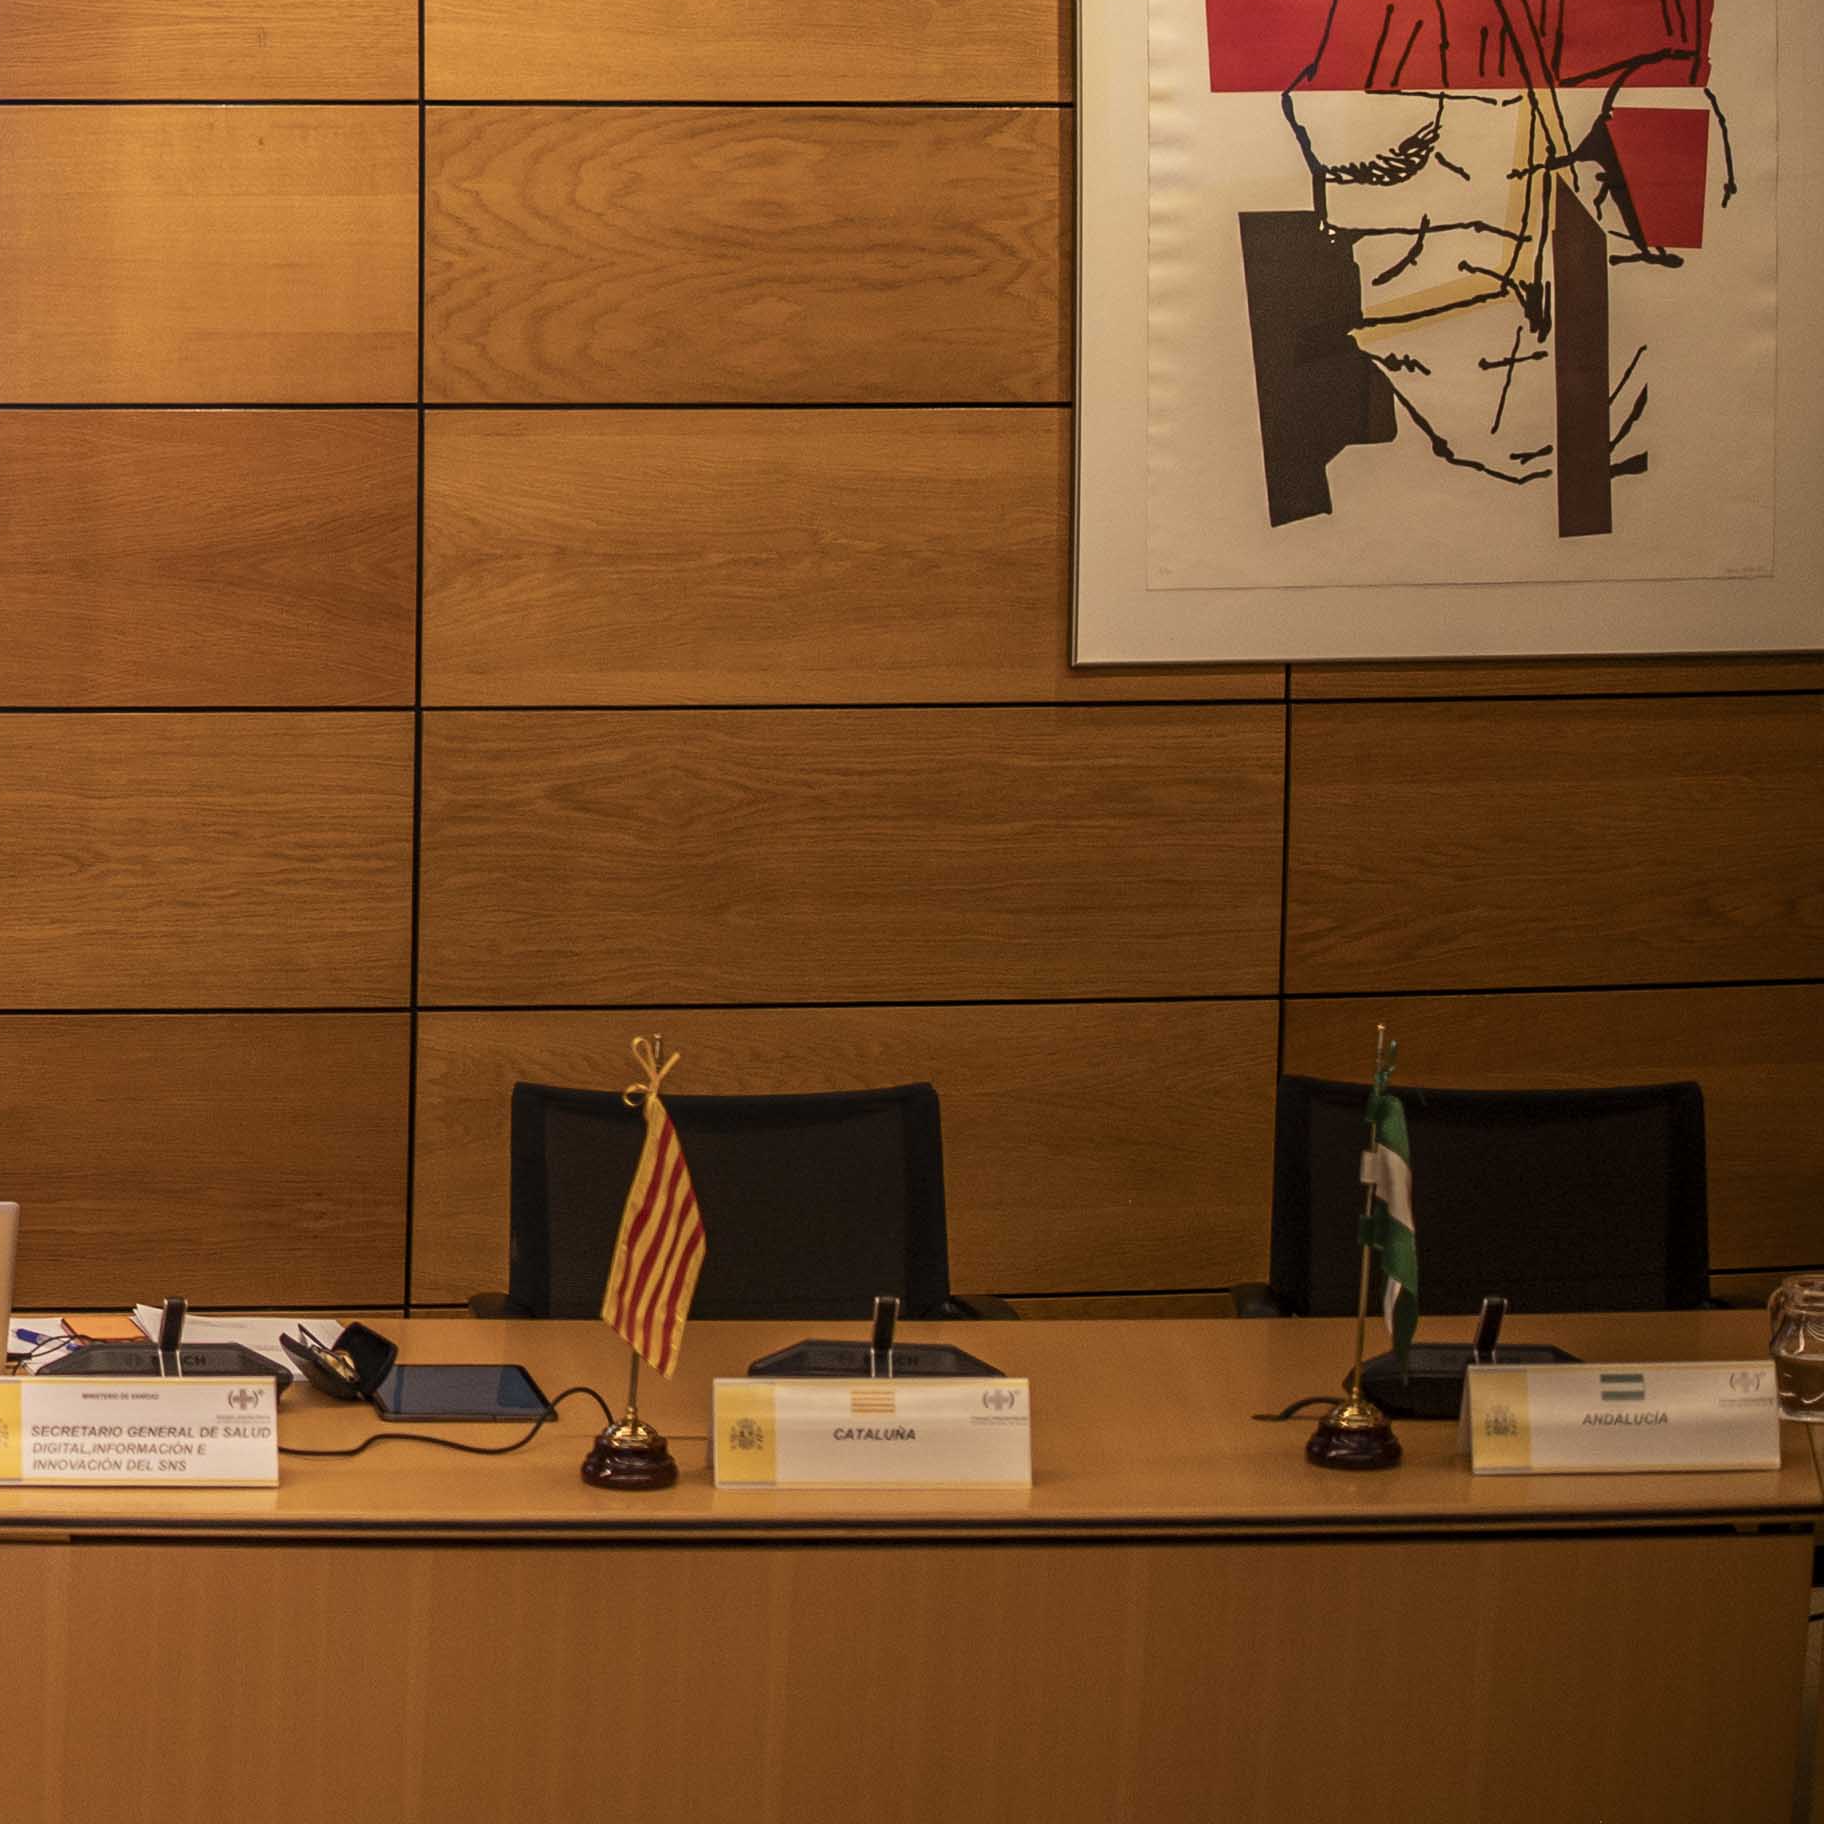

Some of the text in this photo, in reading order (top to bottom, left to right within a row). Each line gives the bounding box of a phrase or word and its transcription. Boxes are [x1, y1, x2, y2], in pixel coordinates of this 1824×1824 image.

[1582, 1411, 1669, 1426] ANDALUCÍA
[31, 1425, 272, 1439] SECRETARIO GENERAL DE SALUD
[833, 1426, 916, 1441] CATALUÑA
[197, 1442, 207, 1455] E
[32, 1456, 188, 1472] INNOVACIÓN DEL SNS
